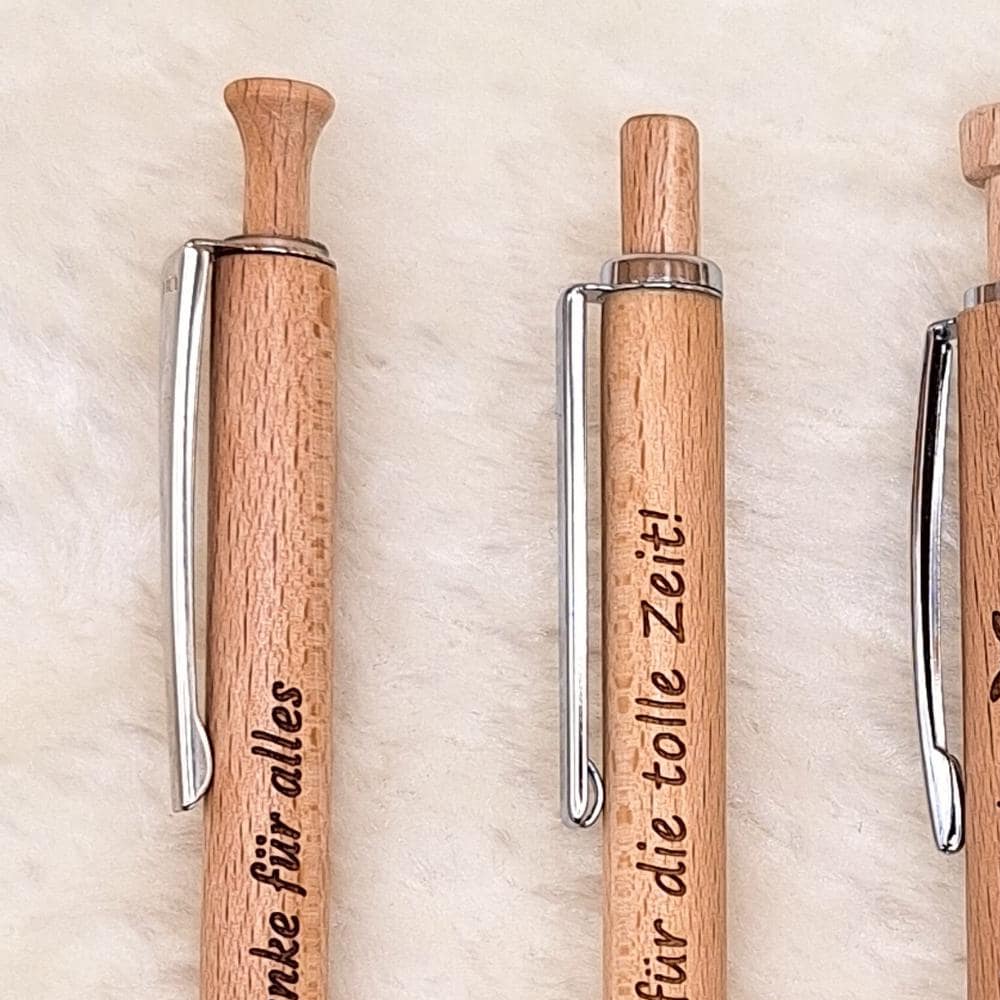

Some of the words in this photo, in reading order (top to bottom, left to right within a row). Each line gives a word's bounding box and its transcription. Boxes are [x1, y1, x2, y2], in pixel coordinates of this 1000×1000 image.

[636, 509, 686, 645] Zeit!
[251, 681, 303, 799] alles
[636, 668, 687, 790] tolle
[250, 811, 307, 898] für
[636, 814, 687, 897] die
